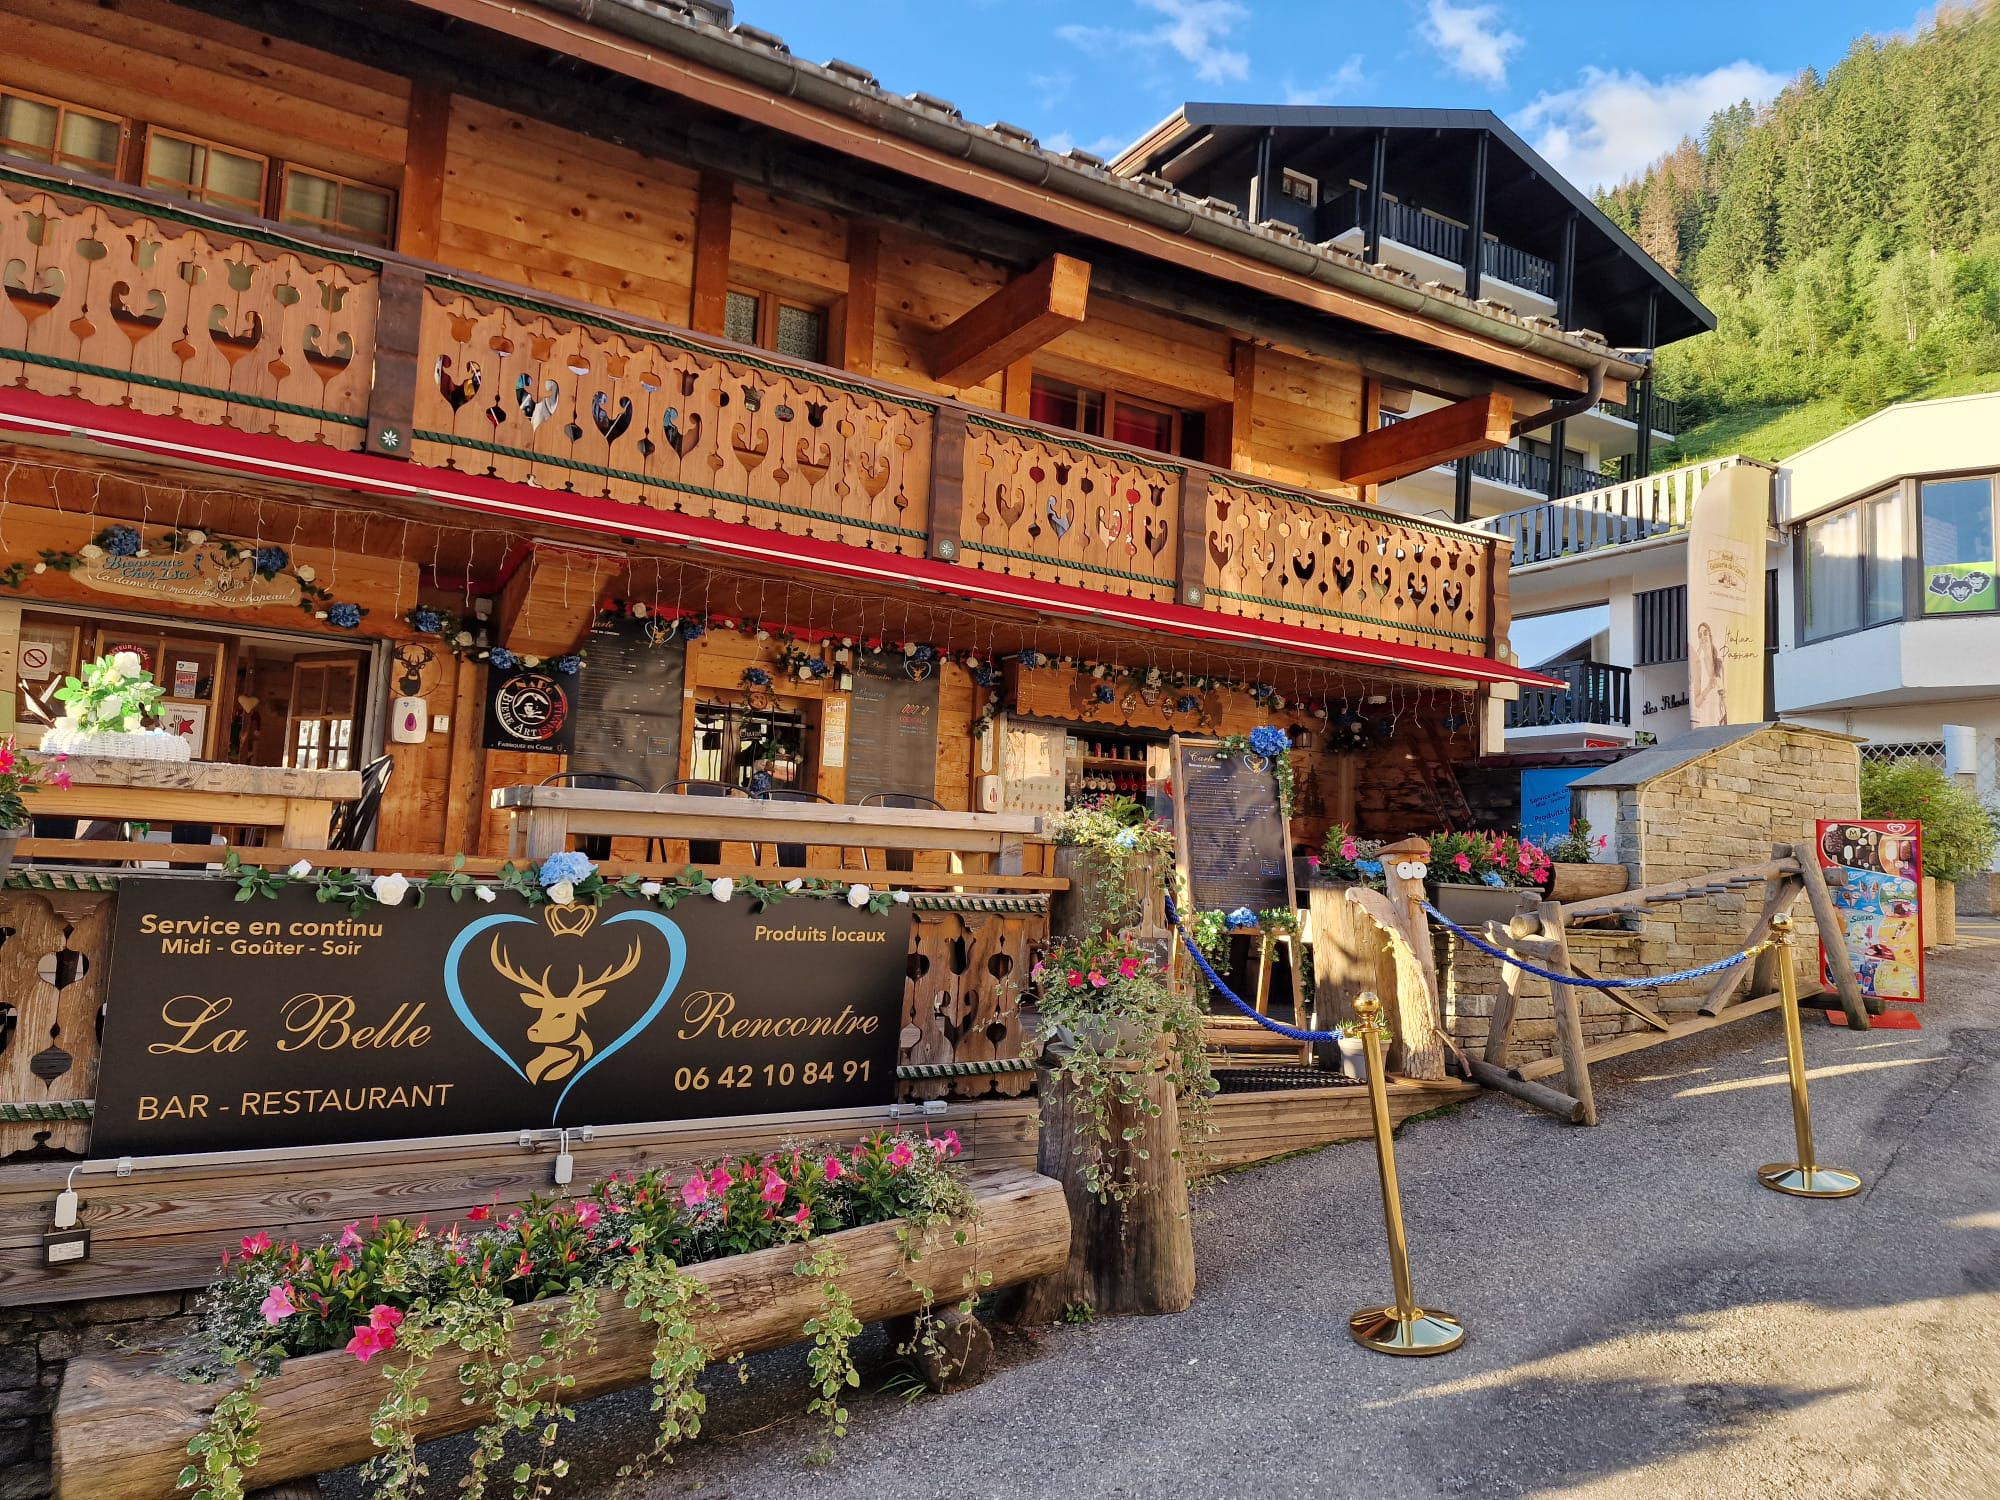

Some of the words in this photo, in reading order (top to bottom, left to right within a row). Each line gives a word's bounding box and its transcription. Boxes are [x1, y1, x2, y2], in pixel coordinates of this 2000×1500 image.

[102, 554, 185, 570] Bienvenue
[120, 567, 158, 582] Chez
[113, 574, 146, 588] dame
[149, 580, 167, 591] des
[169, 584, 219, 599] montagnes
[221, 594, 237, 603] au
[1642, 701, 1658, 715] Les
[1534, 809, 1564, 822] Produits
[139, 913, 241, 935] Service
[248, 921, 281, 936] en
[289, 918, 383, 937] continu
[754, 925, 828, 943] Produits
[831, 925, 887, 943] locaux
[161, 938, 211, 955] Midi
[230, 938, 305, 956] Goûter
[321, 940, 363, 956] Soir
[147, 994, 249, 1055] La
[276, 993, 432, 1052] Belle
[676, 990, 880, 1040] Rencontre
[674, 1066, 710, 1091] 06
[717, 1064, 753, 1088] 42
[763, 1063, 796, 1086] 10
[802, 1061, 834, 1085] 84
[843, 1059, 871, 1082] 91
[137, 1094, 209, 1121] BAR
[241, 1083, 454, 1116] RESTAURANT
